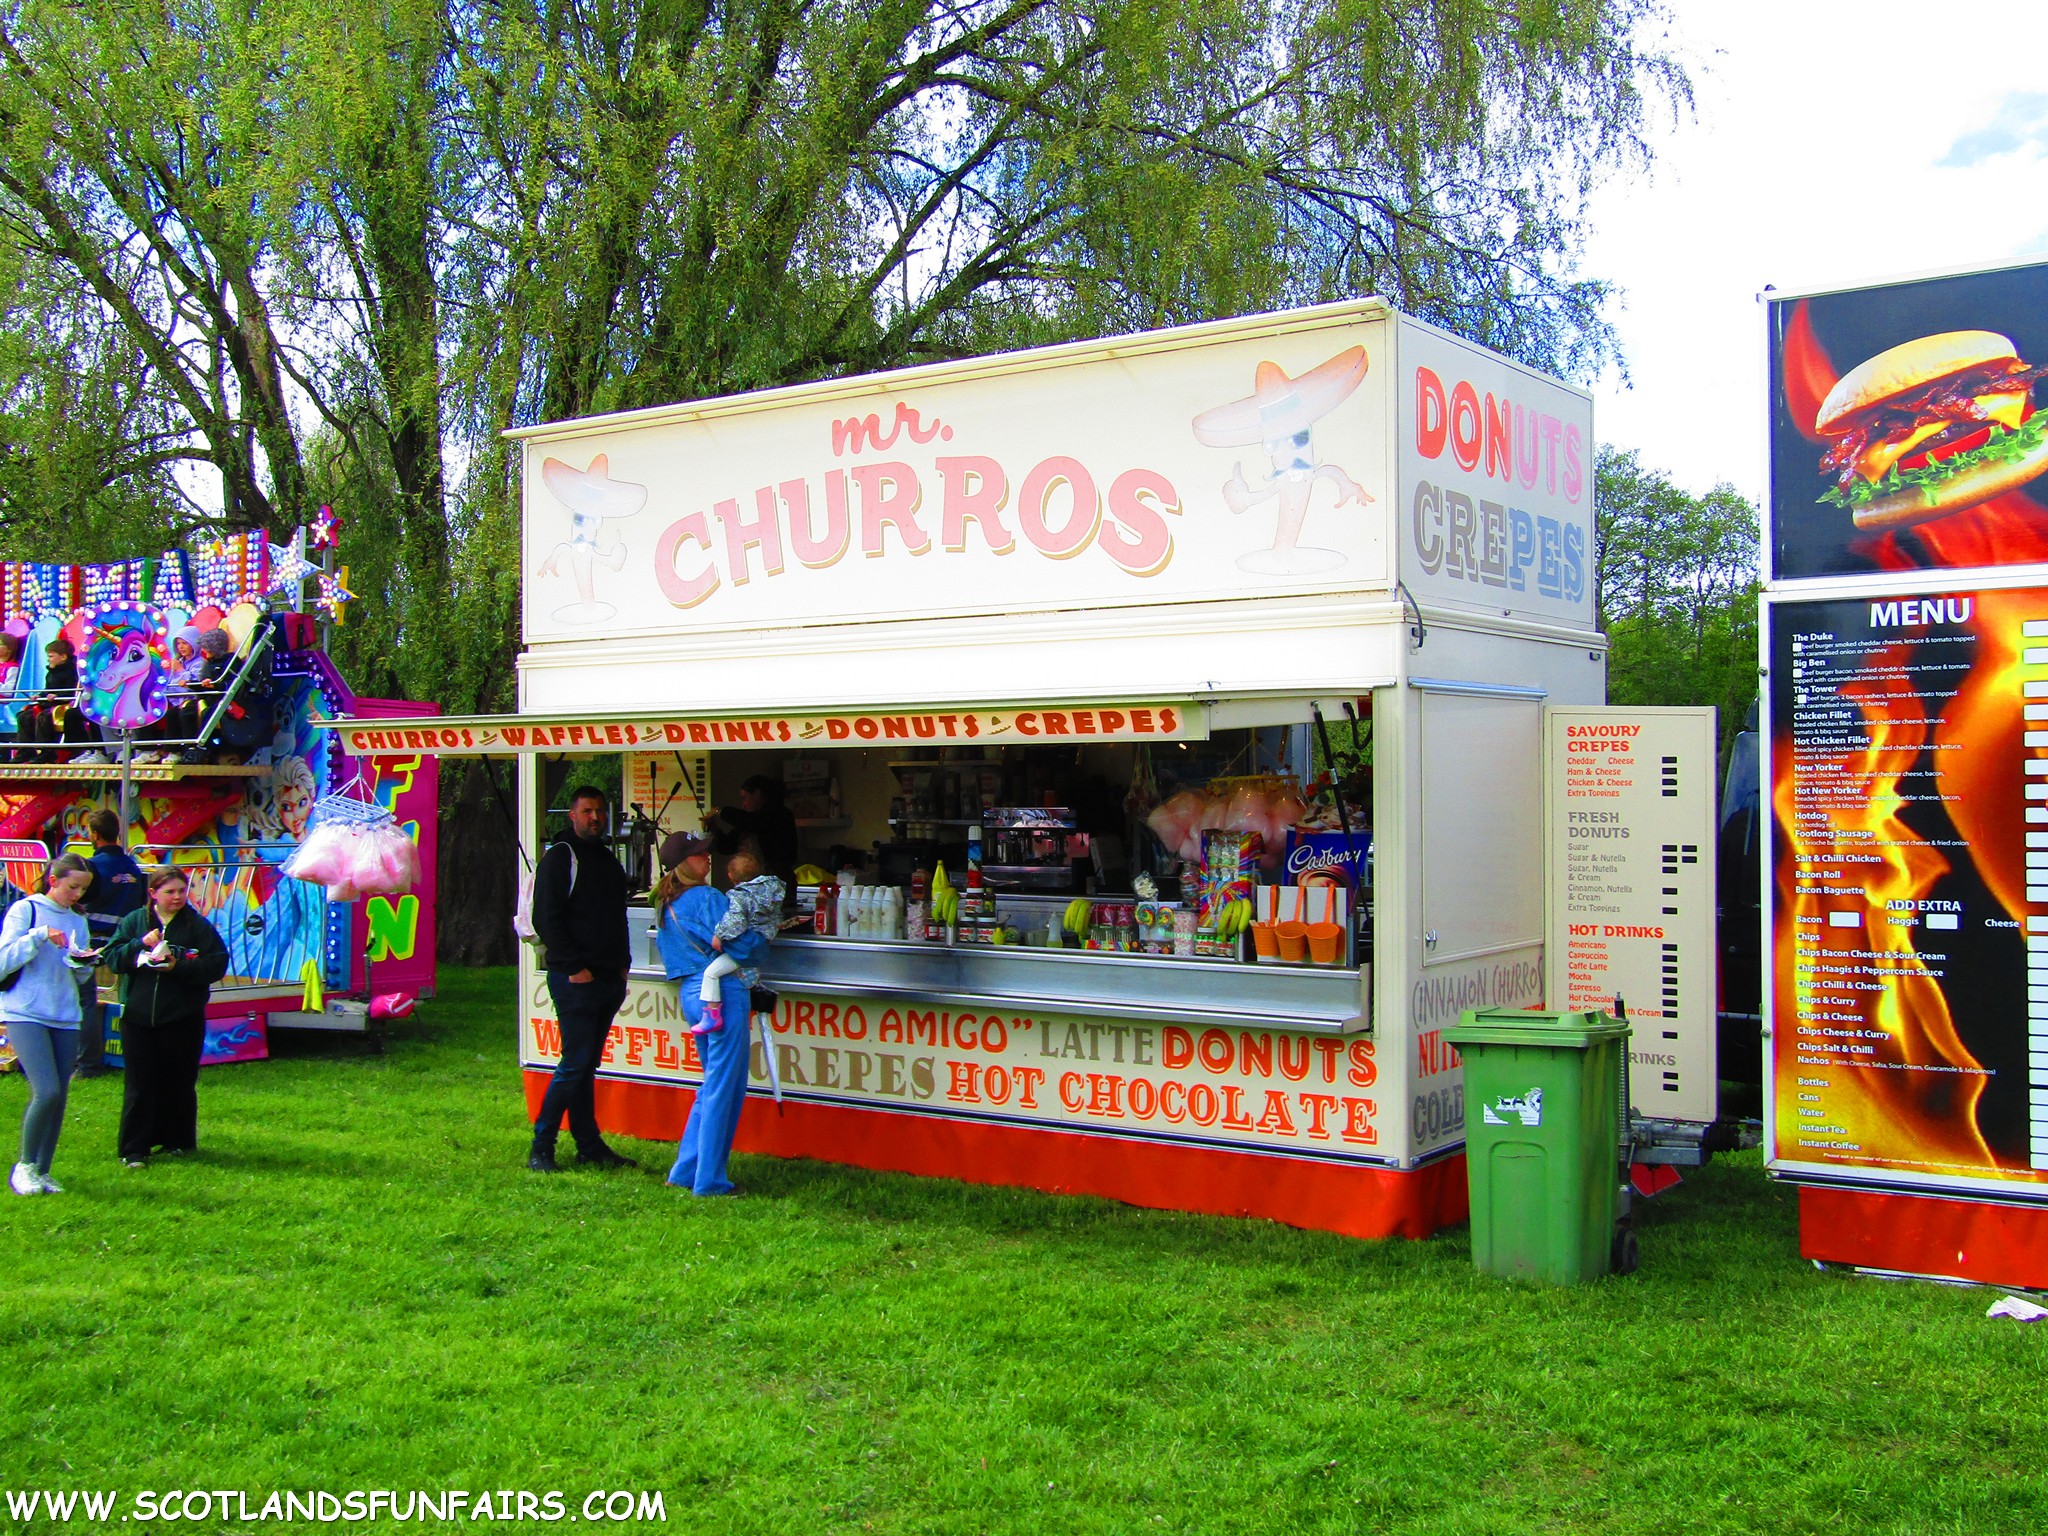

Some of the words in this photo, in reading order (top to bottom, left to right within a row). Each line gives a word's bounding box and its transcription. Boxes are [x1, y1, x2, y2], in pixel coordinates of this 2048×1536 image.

[831, 401, 954, 457] mr.
[1416, 366, 1582, 504] DONUTS
[655, 455, 1183, 611] CHURROS
[1413, 480, 1585, 603] CREPES
[0, 562, 80, 610] INI
[1870, 598, 1970, 627] MENU
[1792, 634, 1808, 642] The
[1810, 633, 1833, 641] Duke
[1793, 660, 1807, 668] Big
[1794, 712, 1828, 720] Chicken
[1830, 711, 1851, 719] Fillet
[351, 728, 473, 750] CHURROS
[501, 724, 637, 747] WAFFLES
[664, 719, 791, 743] DRINKS
[826, 714, 980, 740] DONUTS
[1015, 708, 1177, 736] CREPES
[1567, 725, 1640, 737] SAVOURY
[1568, 741, 1630, 752] CREPES
[1794, 737, 1809, 745] Hot
[1568, 812, 1619, 823] FRESH
[1795, 812, 1827, 821] Hotdog
[1568, 827, 1630, 838] DONUTS
[1795, 830, 1833, 839] Footlong
[1836, 830, 1873, 839] Sausage
[2, 846, 20, 856] WAY
[23, 846, 34, 857] IN
[1287, 845, 1361, 873] Cadbury
[1600, 854, 1626, 862] Nutella
[1846, 855, 1881, 863] Chicken
[1607, 885, 1632, 893] Nutella
[1823, 887, 1864, 895] Baguette
[1589, 904, 1620, 912] Toppings
[1886, 900, 1915, 910] ADD
[1918, 900, 1961, 911] EXTRA
[1887, 917, 1919, 926] Haggis
[1984, 919, 2020, 928] Cheese
[1568, 924, 1598, 935] HOT
[1603, 925, 1664, 938] DRINKS
[1796, 933, 1820, 941] Chips
[1569, 941, 1606, 949] Americano
[1569, 952, 1608, 960] Cappuccino
[1796, 949, 1820, 957] Chips
[1822, 949, 1848, 957] Bacon
[1851, 950, 1882, 958] Cheese
[1916, 952, 1946, 960] Cream
[1569, 962, 1587, 970] Caffe
[1589, 962, 1608, 971] Latte
[1797, 964, 1820, 973] Chips
[1822, 965, 1852, 974] Haagis
[1862, 967, 1914, 976] Peppercorn
[1916, 969, 1944, 977] Sauce
[1569, 973, 1592, 981] Mocha
[1569, 983, 1601, 992] Espresso
[1797, 980, 1821, 989] Chips
[1855, 982, 1888, 990] Cheese
[1413, 968, 1486, 1029] CINNAMON
[1493, 956, 1543, 1006] CHURROS
[1797, 996, 1821, 1004] Chips
[1831, 997, 1856, 1006] Curry
[1638, 1009, 1661, 1017] Cream
[1797, 1012, 1821, 1020] Chips
[1823, 1012, 1829, 1020] &
[1831, 1012, 1863, 1021] Cheese
[1797, 1027, 1821, 1035] Chips
[1823, 1028, 1855, 1037] Cheese
[1856, 1029, 1863, 1037] &
[1865, 1030, 1889, 1039] Curry
[1797, 1042, 1821, 1051] Chips
[1823, 1044, 1840, 1052] Salt
[1850, 1046, 1874, 1054] Chilli
[1040, 1020, 1153, 1065] LATTE
[1162, 1026, 1378, 1088] DONUTS
[1629, 1052, 1676, 1066] RINKS
[1798, 1056, 1830, 1065] Nachos
[531, 1018, 704, 1073] WFFLE
[749, 1041, 936, 1100] CREPES
[946, 1061, 1045, 1109] HOT
[1059, 1071, 1379, 1145] CHOCOLATE
[1798, 1078, 1828, 1087] Bottles
[1798, 1093, 1819, 1101] Cans
[1798, 1108, 1824, 1117] Water
[1798, 1123, 1829, 1133] Instant
[1831, 1125, 1846, 1134] Tea
[1798, 1138, 1830, 1148] Instant
[1831, 1140, 1859, 1151] Coffee
